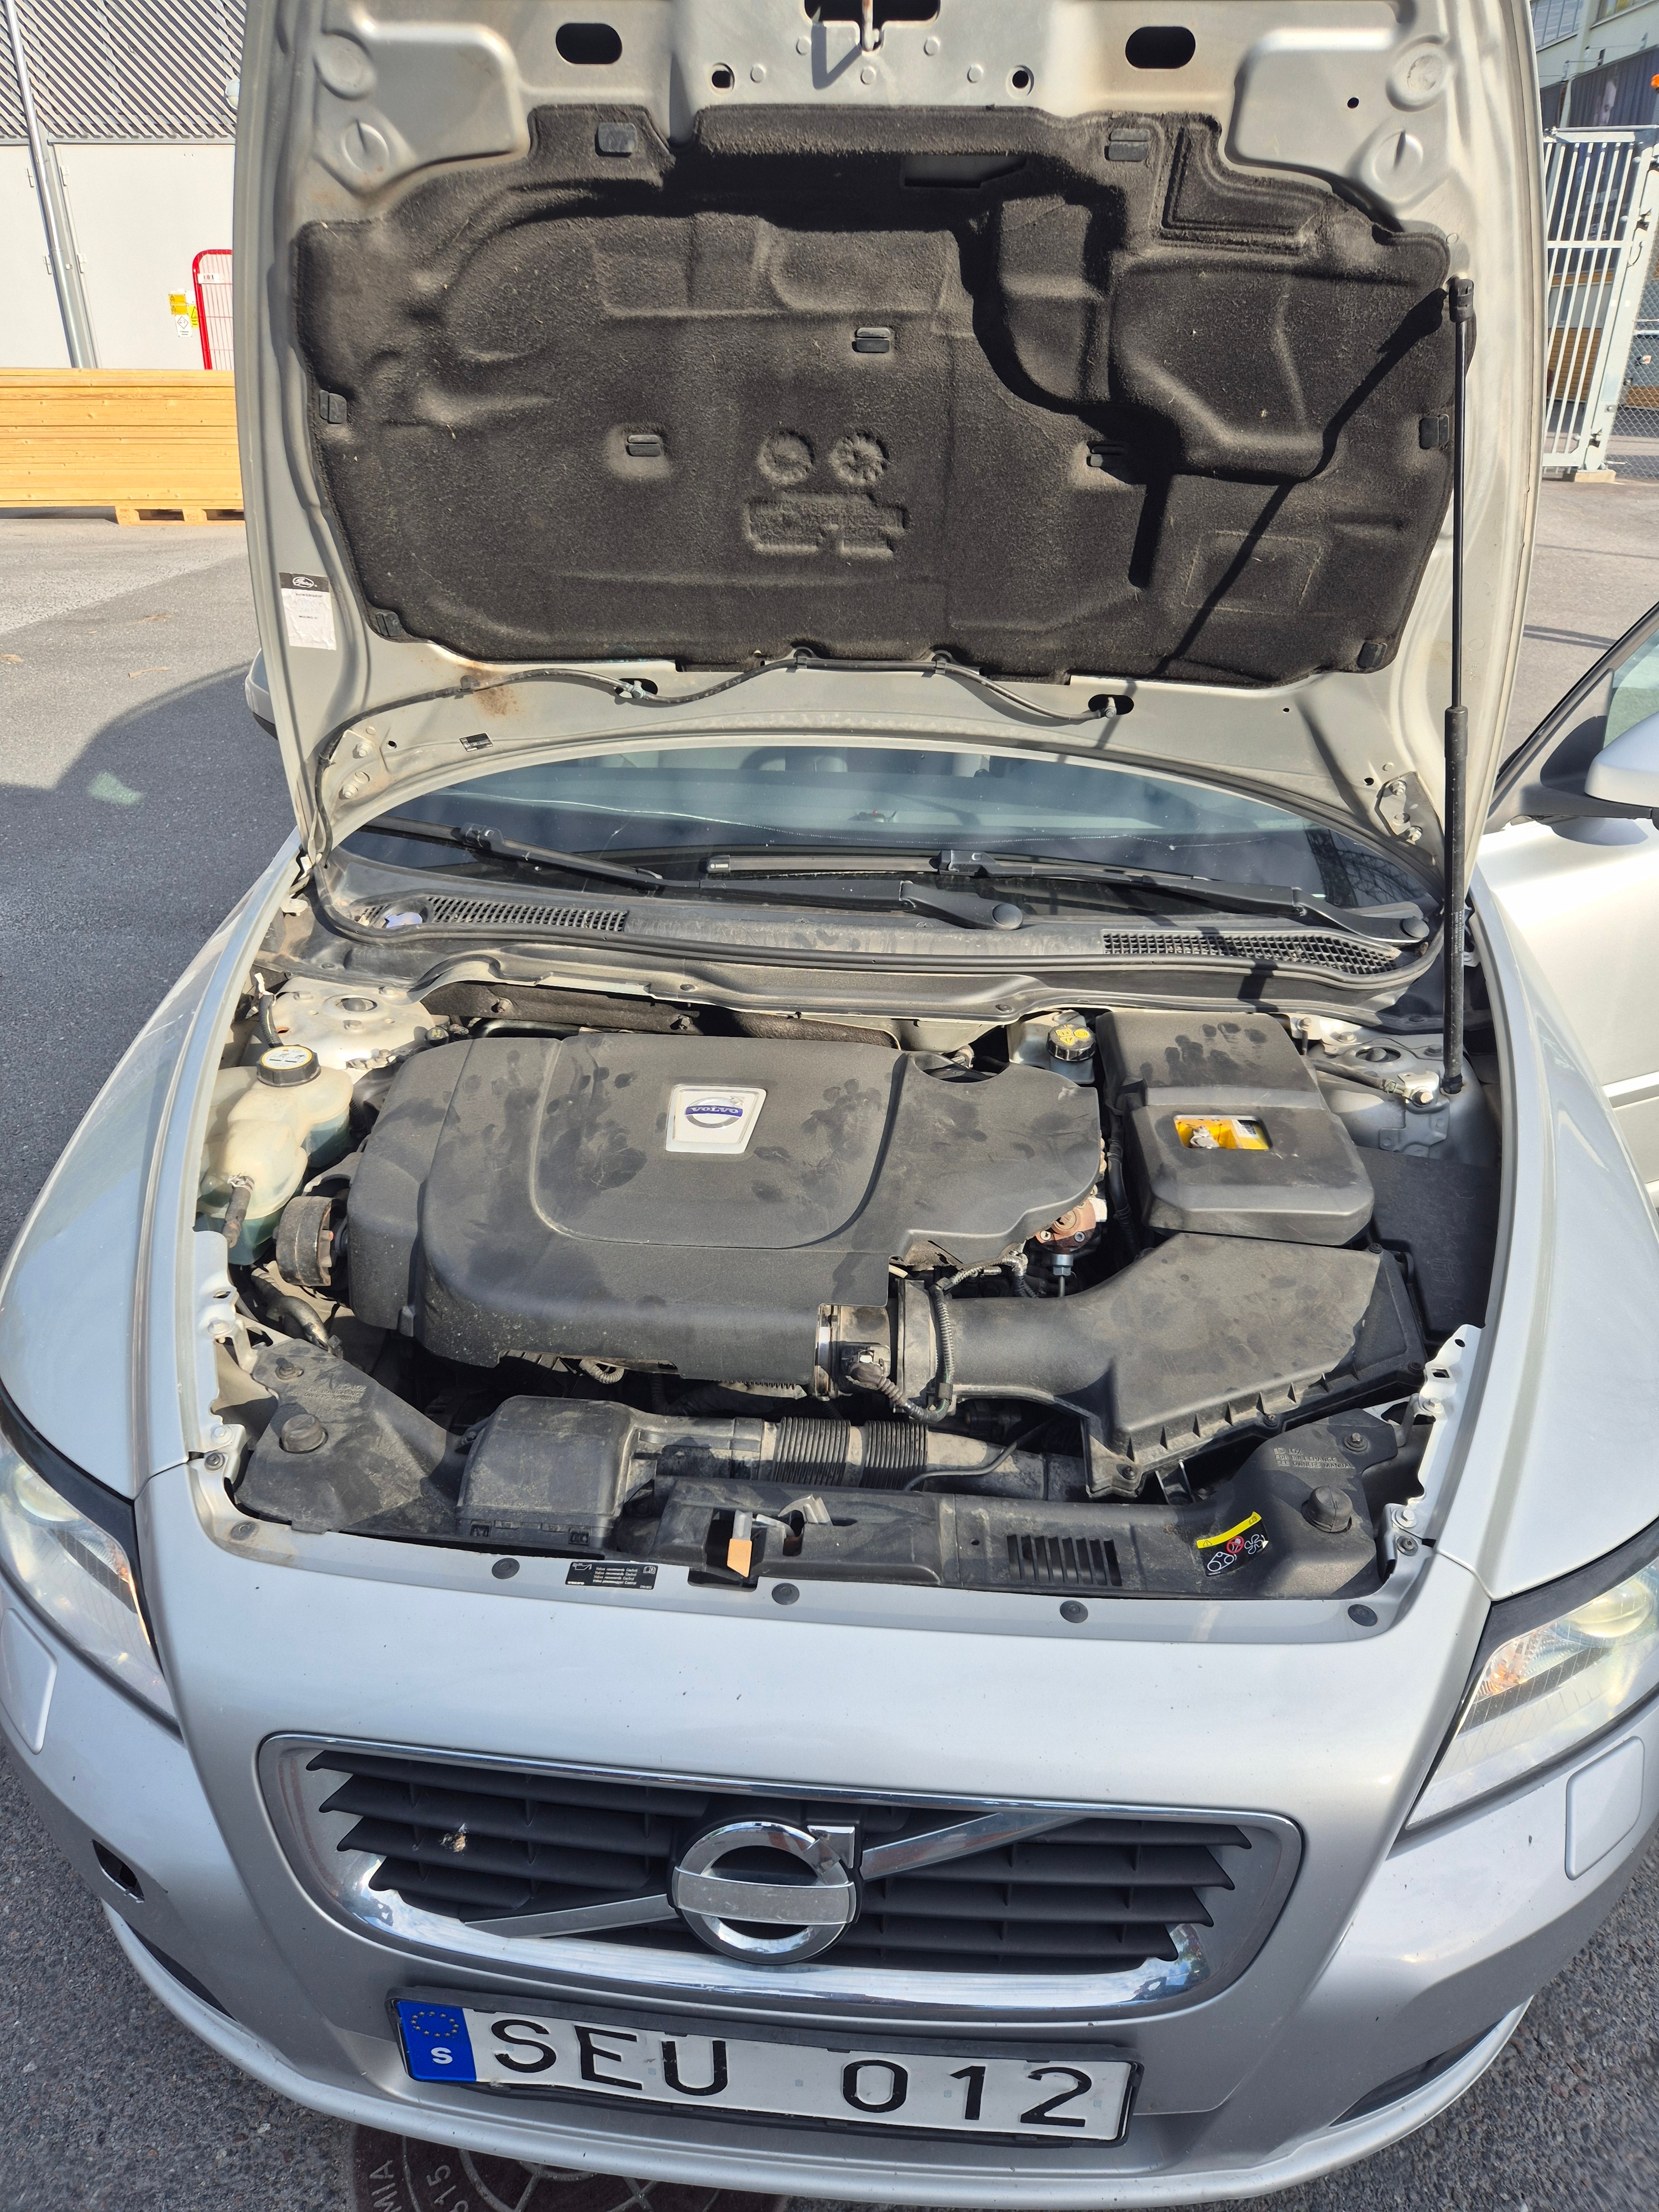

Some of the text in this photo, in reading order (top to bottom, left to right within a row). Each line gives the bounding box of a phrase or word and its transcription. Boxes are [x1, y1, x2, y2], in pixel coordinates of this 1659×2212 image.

[332, 1395, 360, 1403] MANUAL
[431, 2046, 453, 2064] S
[491, 2018, 1093, 2128] SEU 012
